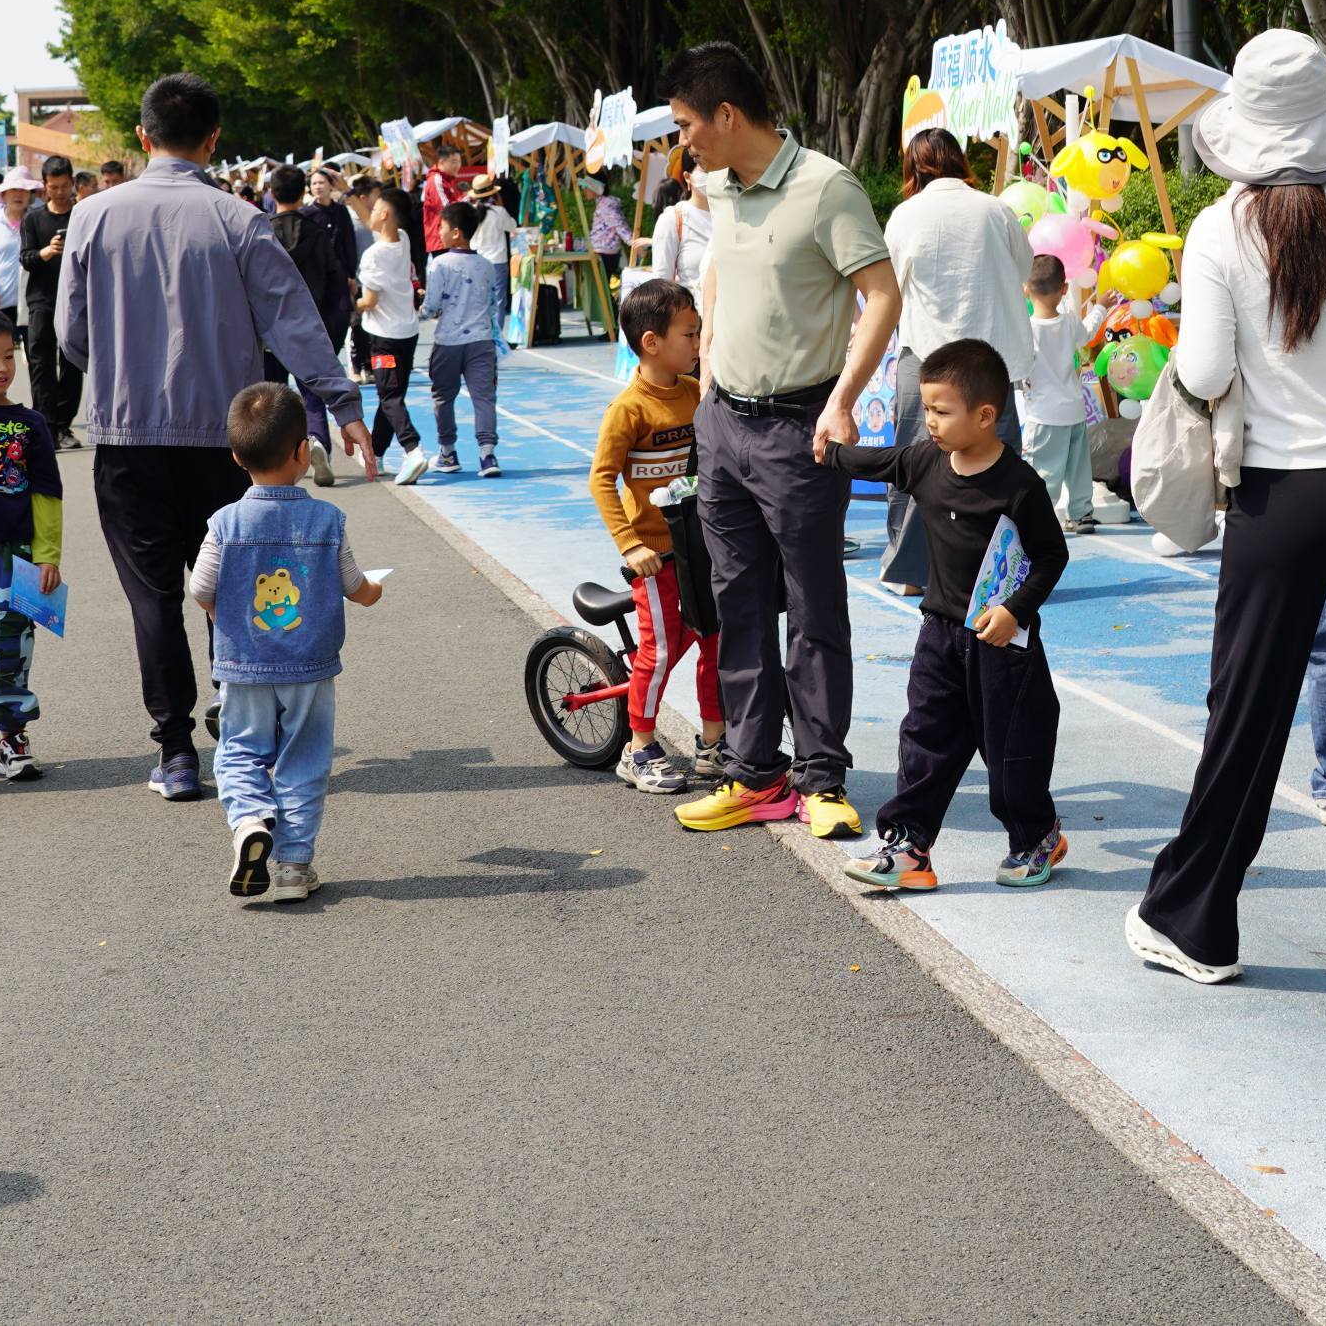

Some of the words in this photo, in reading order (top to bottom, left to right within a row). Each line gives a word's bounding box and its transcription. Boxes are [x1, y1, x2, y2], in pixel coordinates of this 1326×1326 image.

[931, 35, 996, 90] 顺福顺水
[947, 85, 981, 147] River
[981, 70, 1015, 139] Walk
